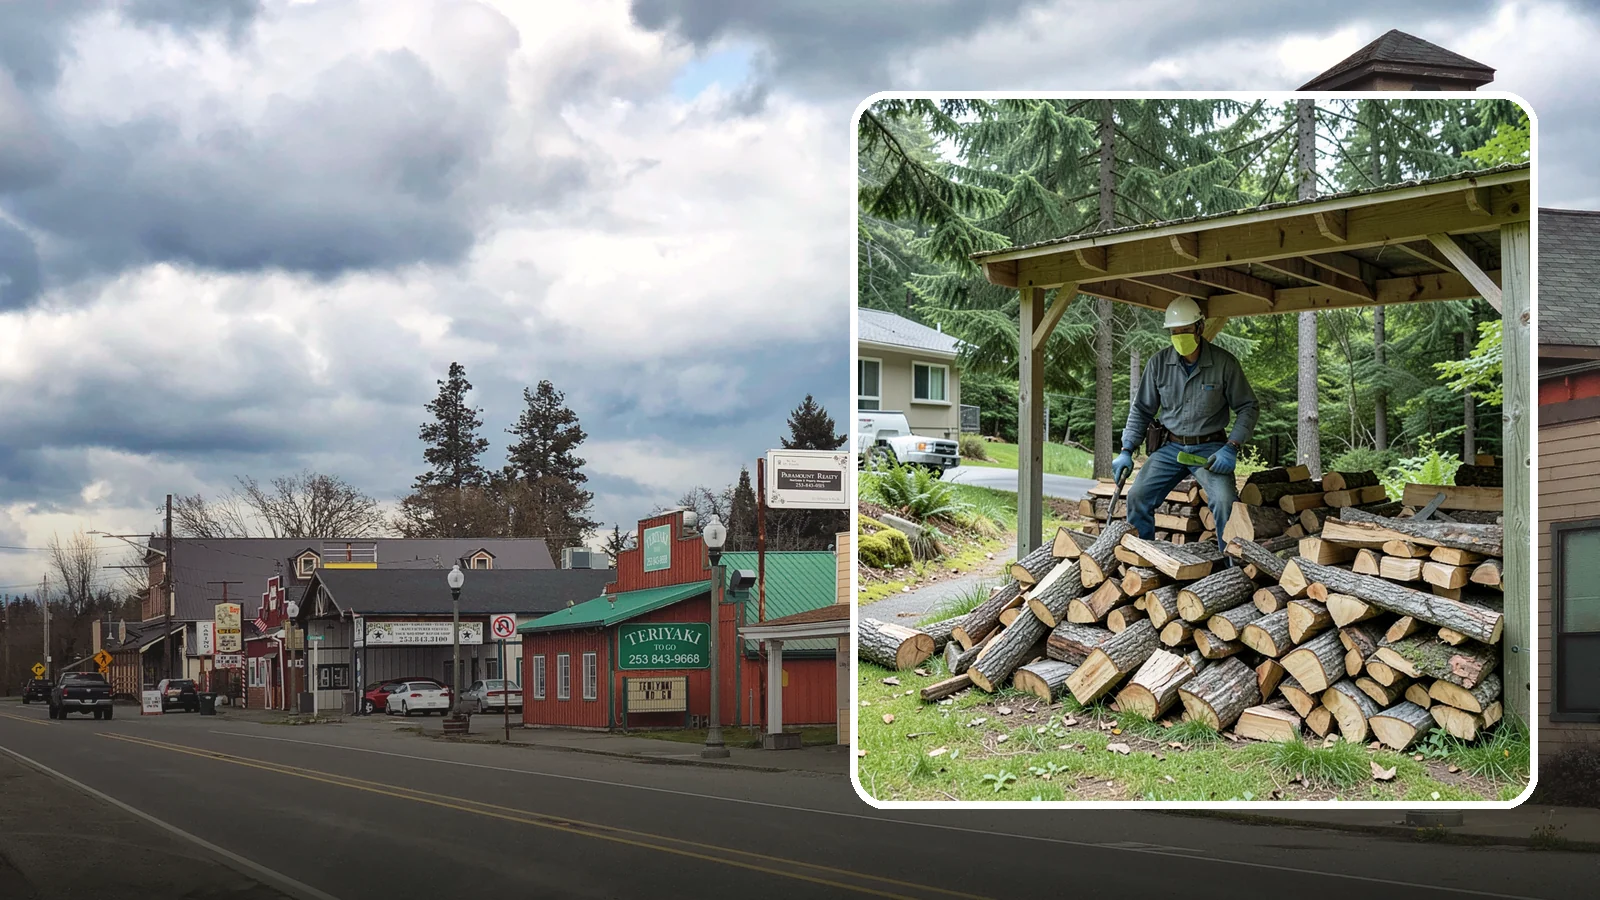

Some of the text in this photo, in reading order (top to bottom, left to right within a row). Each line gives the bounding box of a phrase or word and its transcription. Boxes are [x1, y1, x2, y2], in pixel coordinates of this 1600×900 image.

[624, 627, 702, 646] TERIYAKI
[665, 643, 677, 651] GO
[629, 653, 700, 665] 253 843-9668
